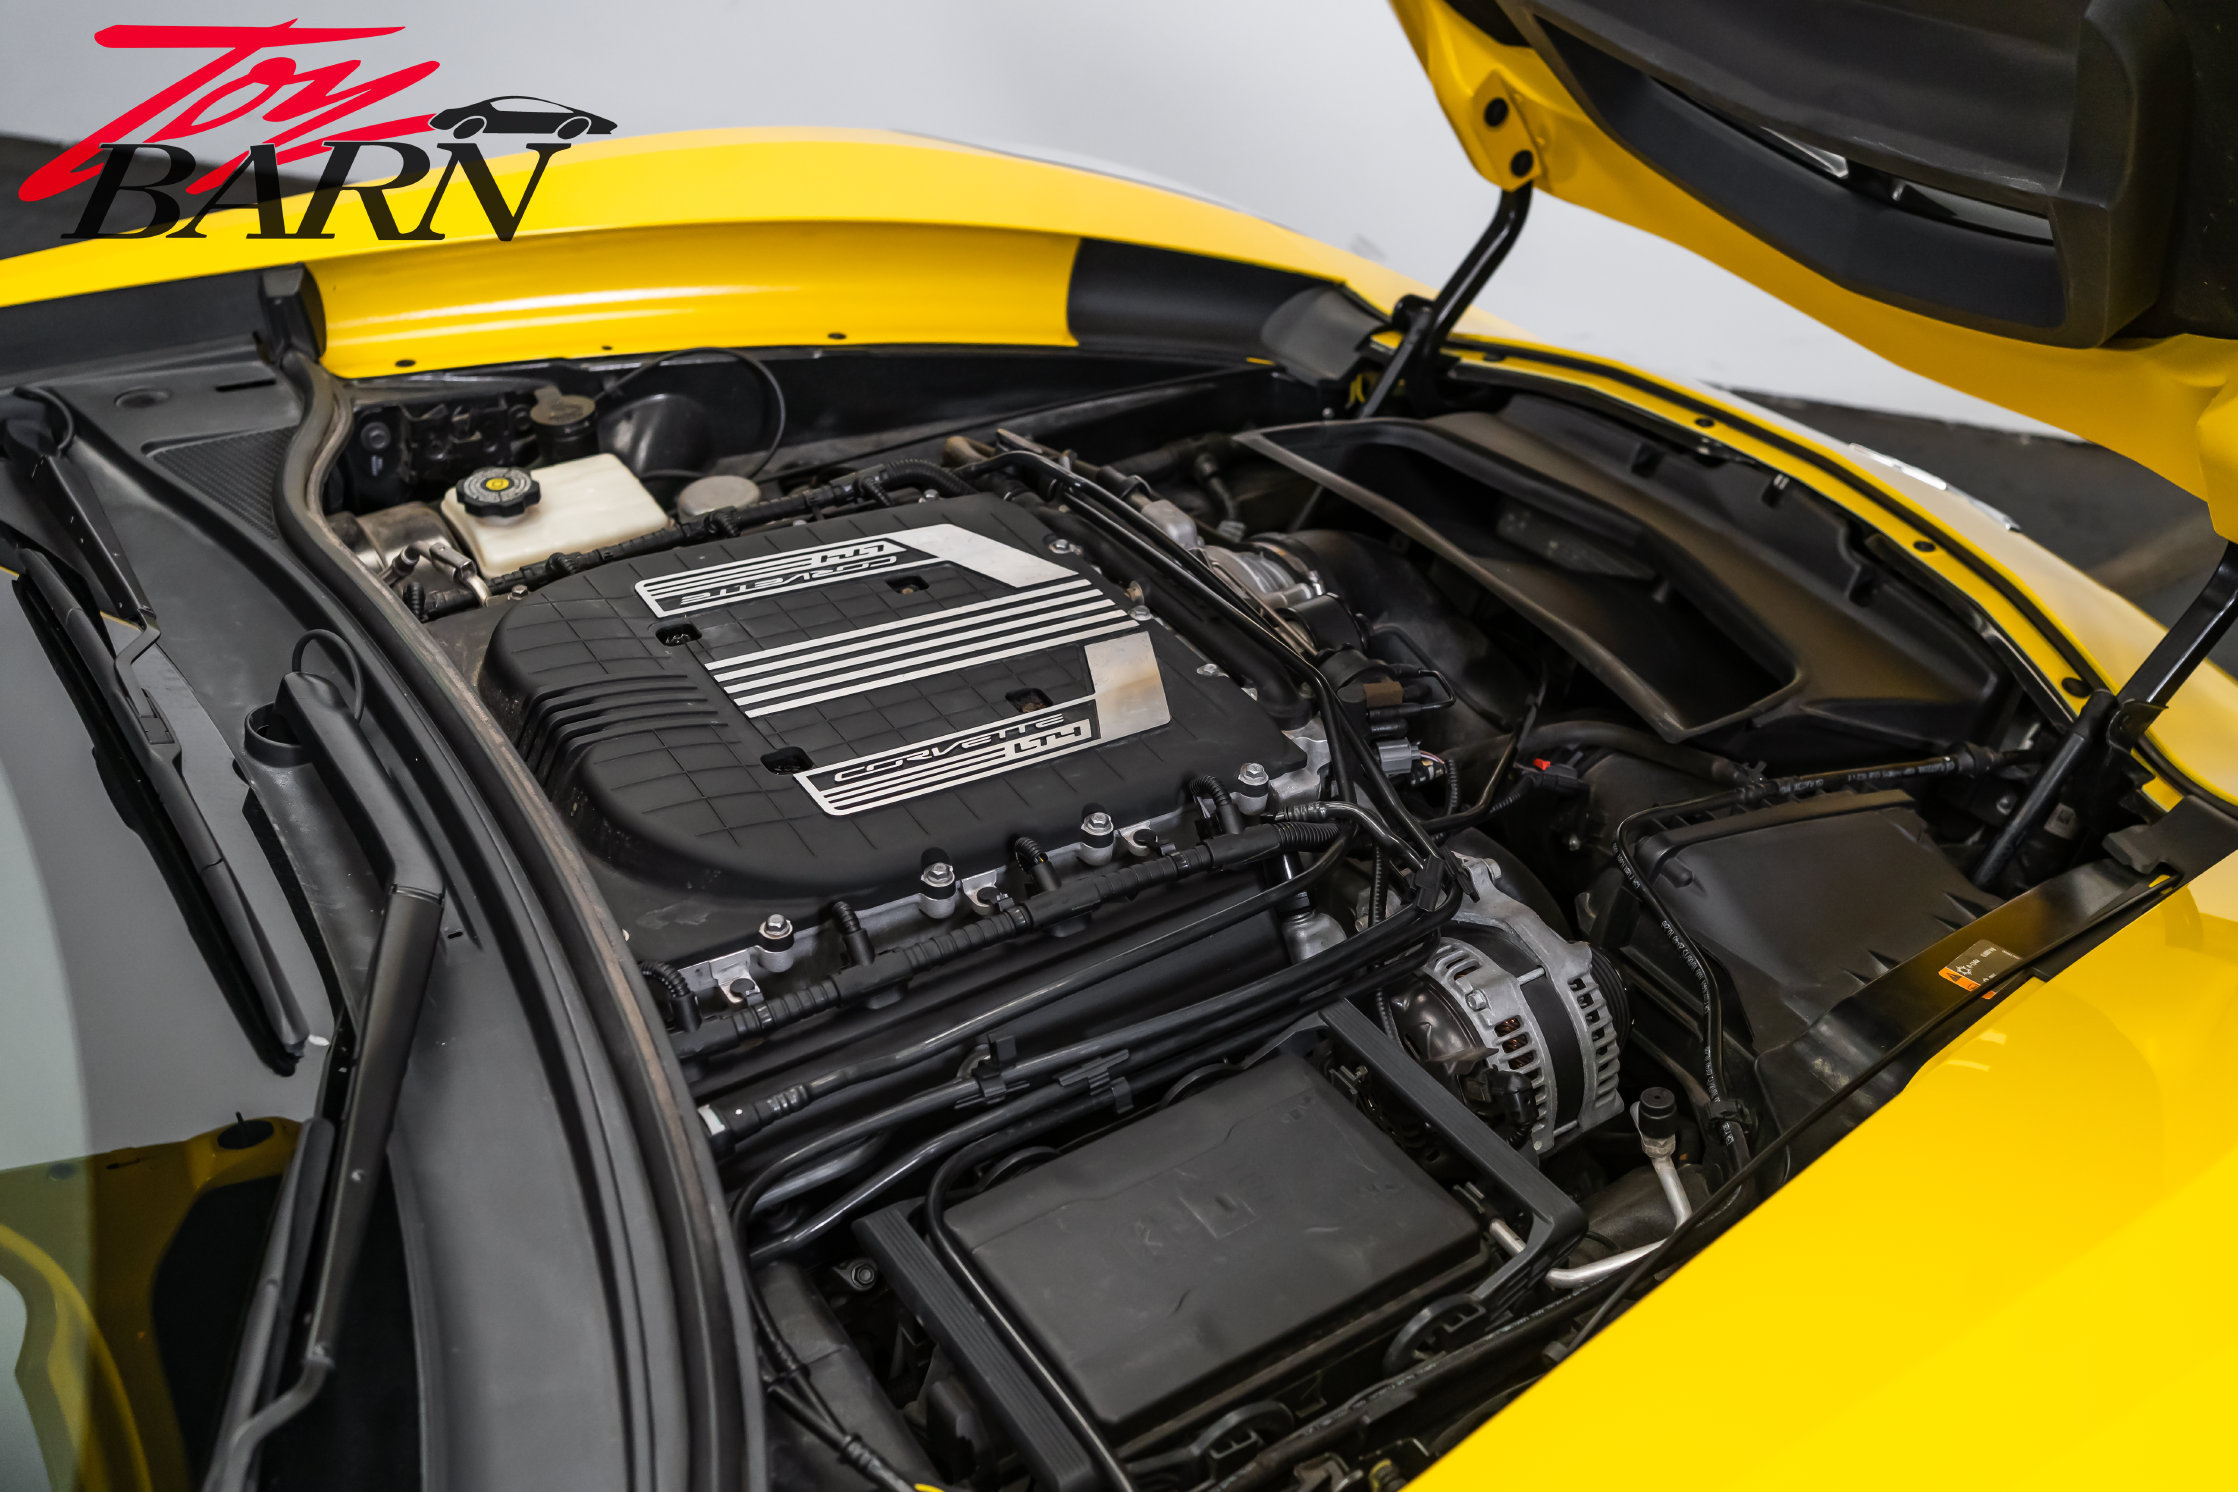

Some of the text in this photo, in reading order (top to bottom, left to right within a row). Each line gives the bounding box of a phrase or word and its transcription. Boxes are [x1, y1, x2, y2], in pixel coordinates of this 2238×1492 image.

[819, 544, 885, 564] LT4
[680, 555, 898, 606] CORVETTE
[834, 713, 1064, 782] CORVETTE
[1013, 725, 1083, 754] LT4
